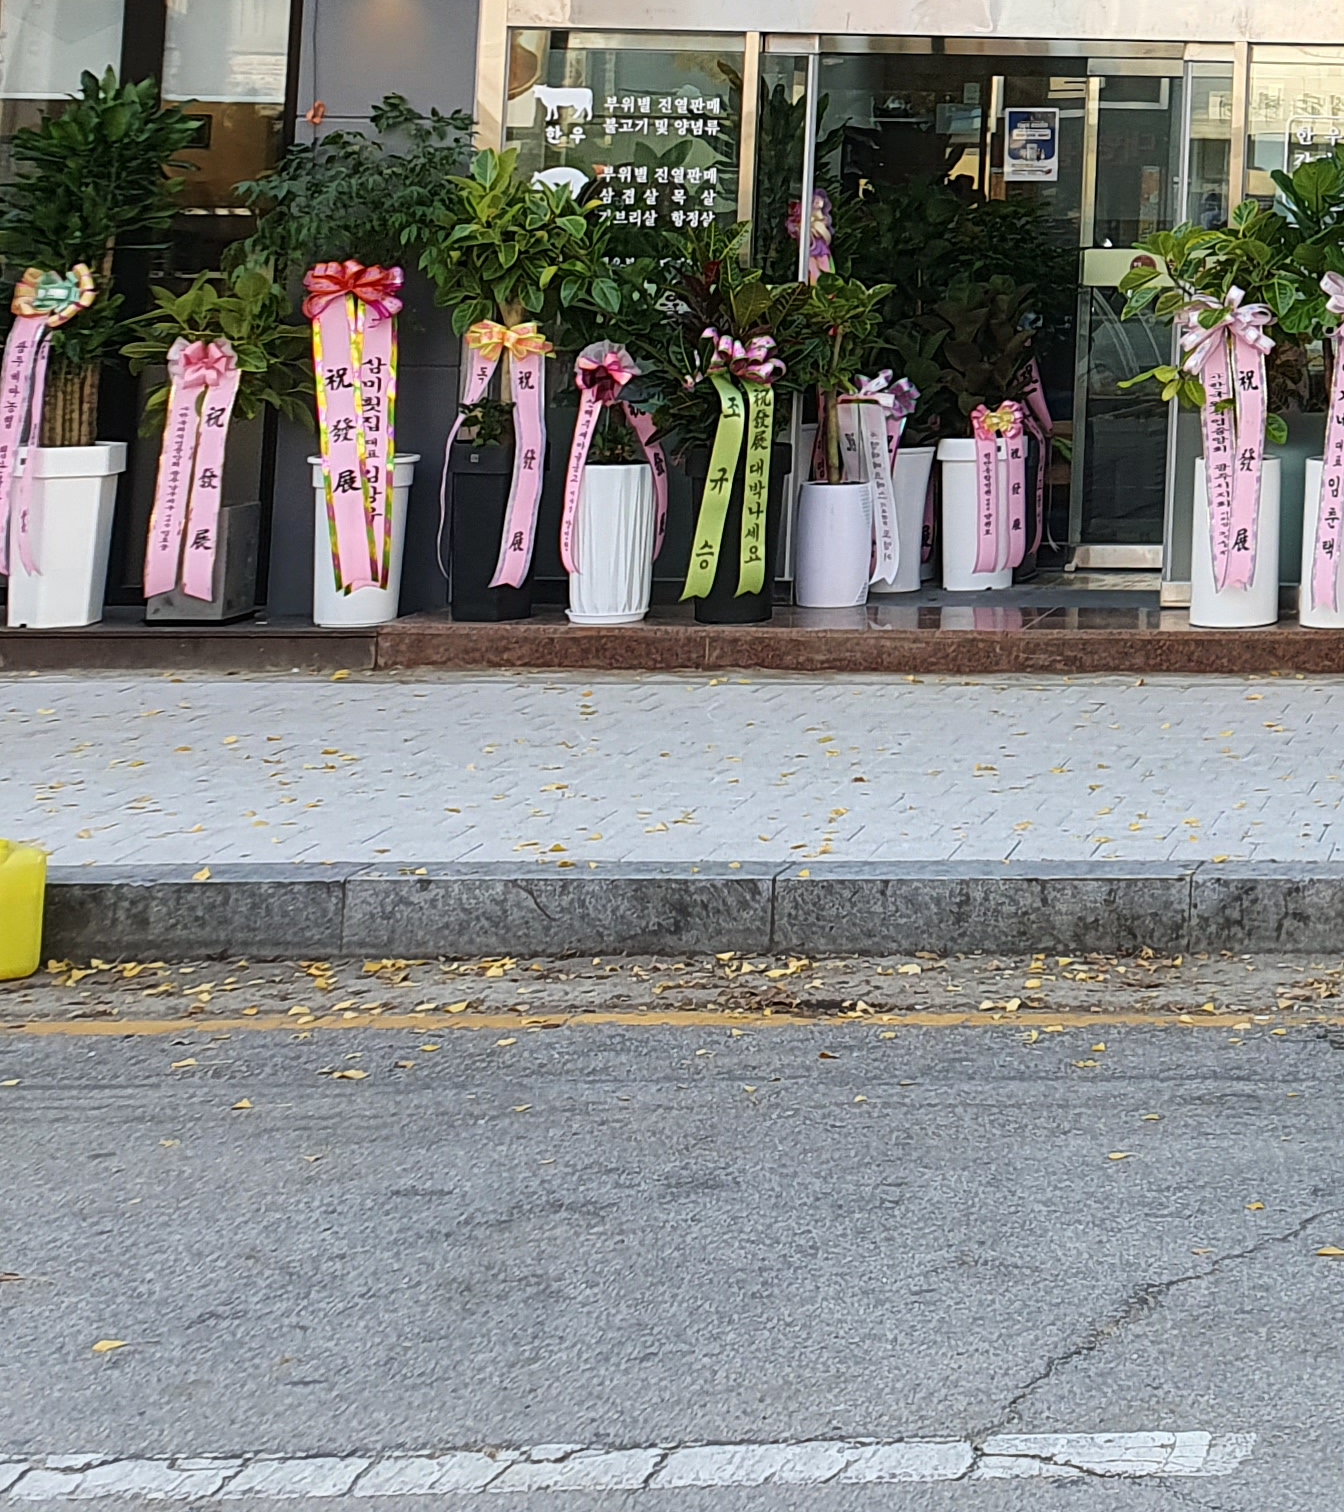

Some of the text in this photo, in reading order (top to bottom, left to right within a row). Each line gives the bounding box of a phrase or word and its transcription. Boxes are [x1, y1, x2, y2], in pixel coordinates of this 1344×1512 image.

[603, 118, 721, 136] 불고기 및 양념류
[604, 96, 721, 115] 부위별 진열판매
[545, 125, 586, 144] 한우
[599, 188, 659, 205] 삼겹살
[602, 166, 718, 184] 부위별 진열판매
[323, 367, 362, 494] 祝發展
[1331, 439, 1344, 468] 대표
[509, 370, 537, 553] 祝發展
[695, 396, 742, 570] 조규승
[743, 389, 772, 564] 祝發展 대박나세요
[1231, 369, 1259, 552] 祝發展
[1321, 476, 1341, 559] 임춘택
